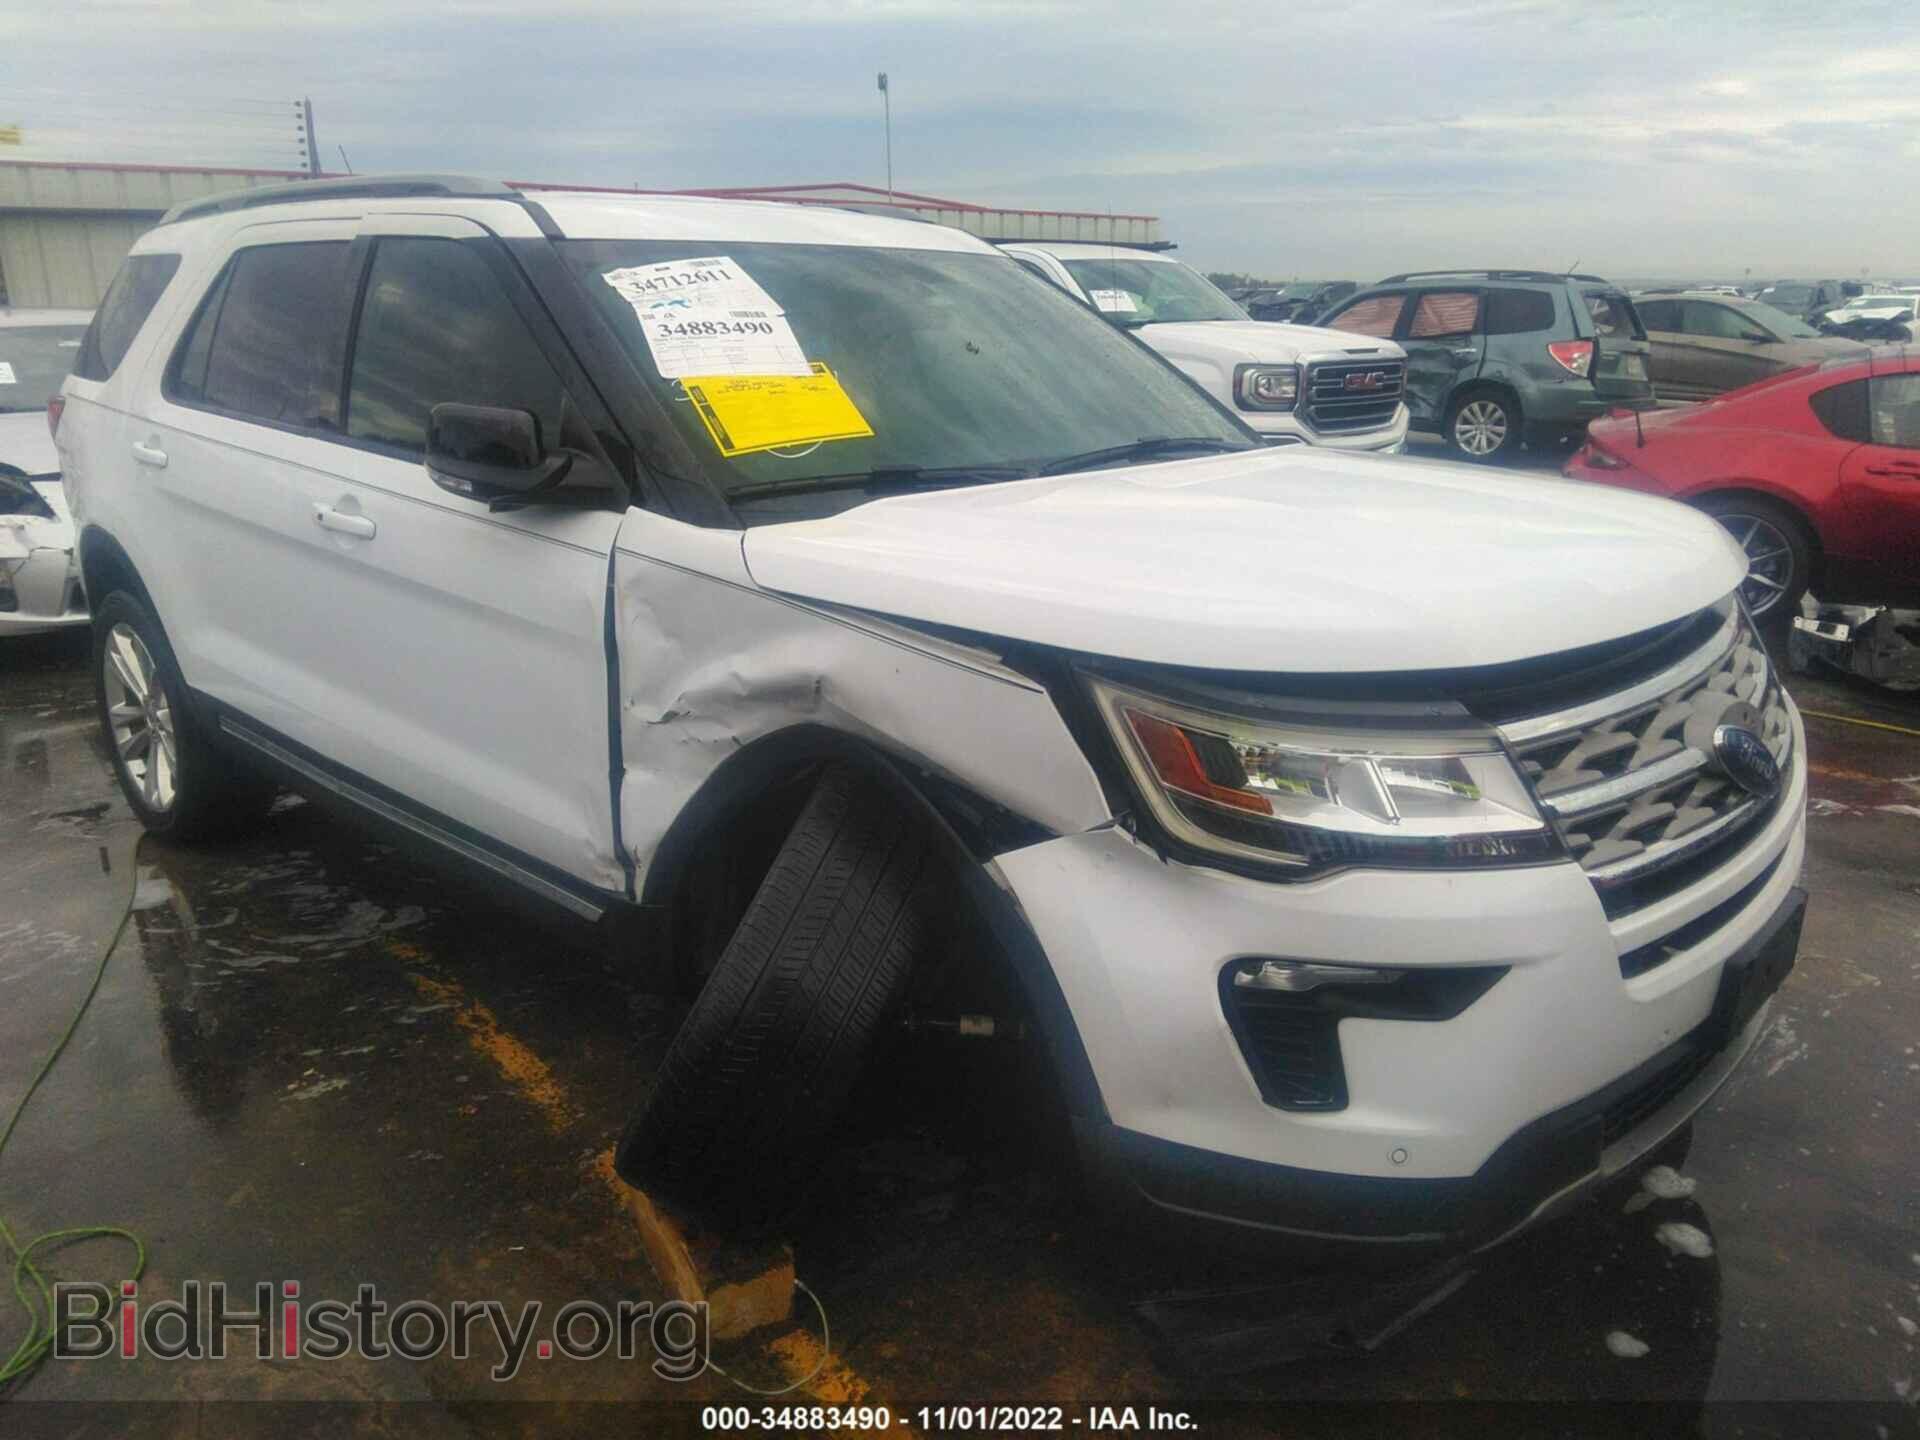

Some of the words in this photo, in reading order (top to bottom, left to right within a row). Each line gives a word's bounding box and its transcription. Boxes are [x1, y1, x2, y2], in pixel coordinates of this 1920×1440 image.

[629, 269, 733, 294] 34712611
[657, 321, 773, 337] 34883490
[1344, 371, 1385, 392] GMC
